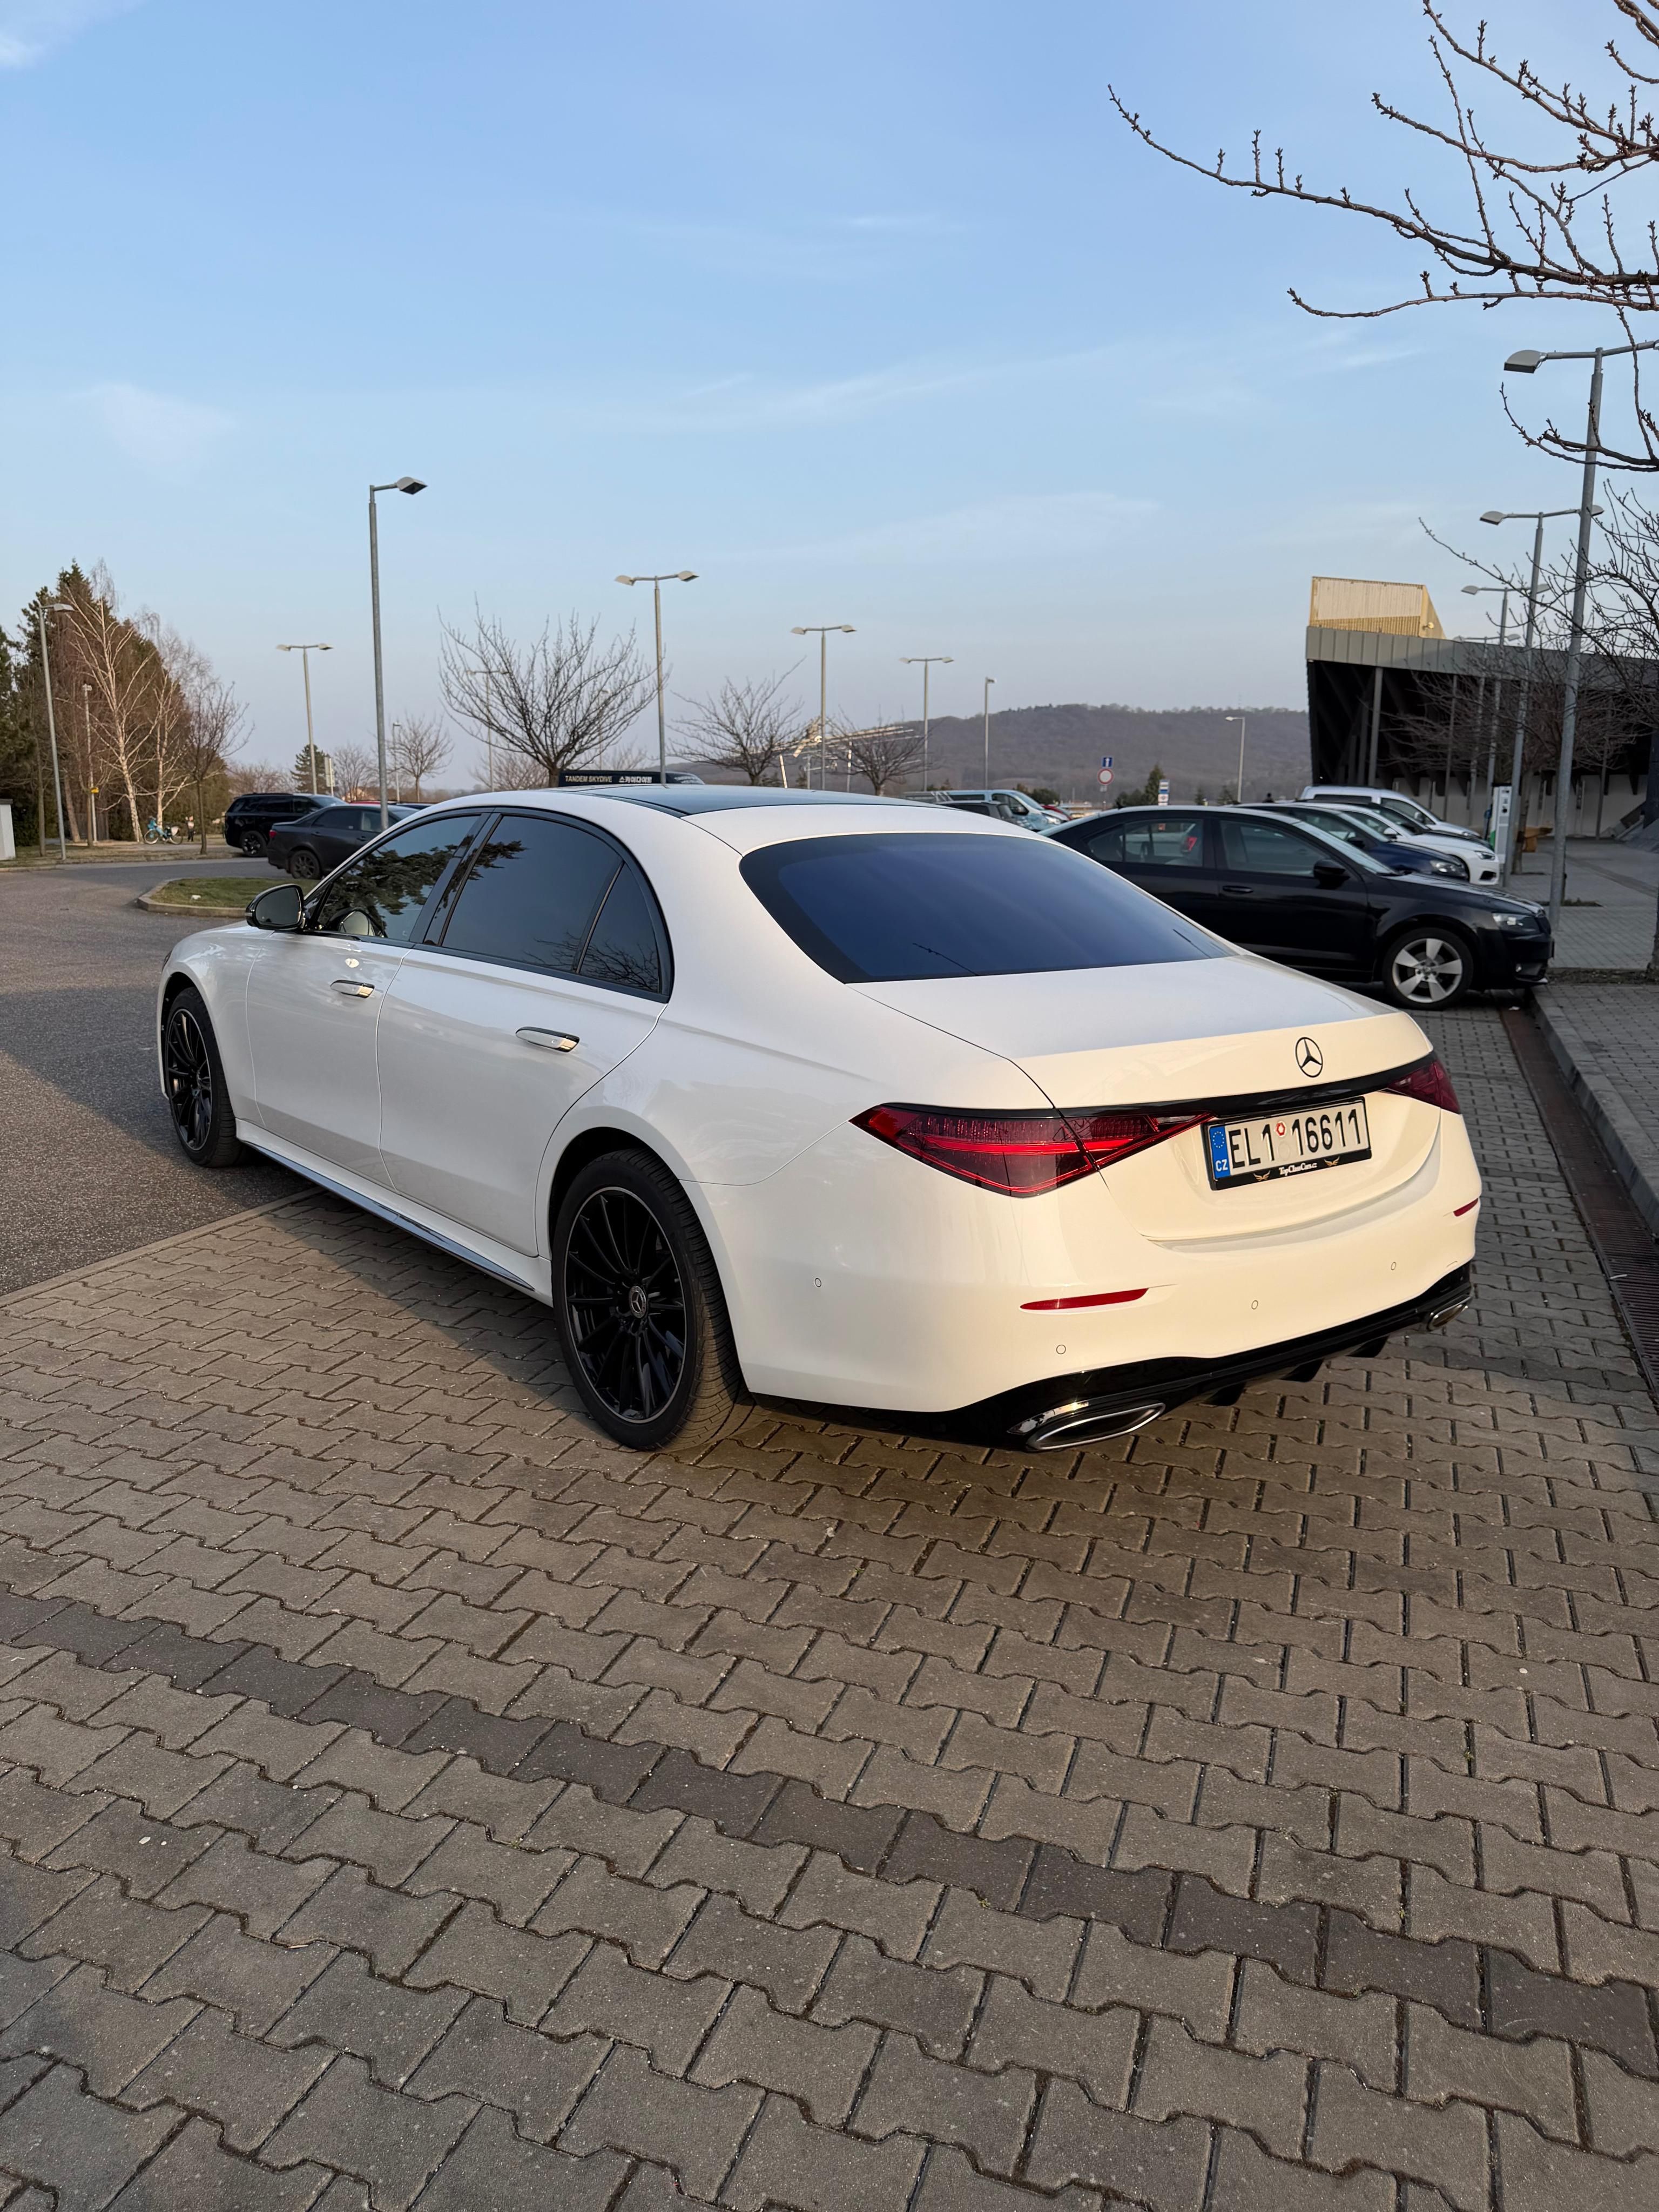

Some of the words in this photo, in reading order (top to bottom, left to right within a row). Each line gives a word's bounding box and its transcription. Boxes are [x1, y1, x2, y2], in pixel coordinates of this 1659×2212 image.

[1228, 1124, 1275, 1169] EL1
[1291, 1109, 1361, 1156] 16611
[1215, 1159, 1228, 1172] CZ
